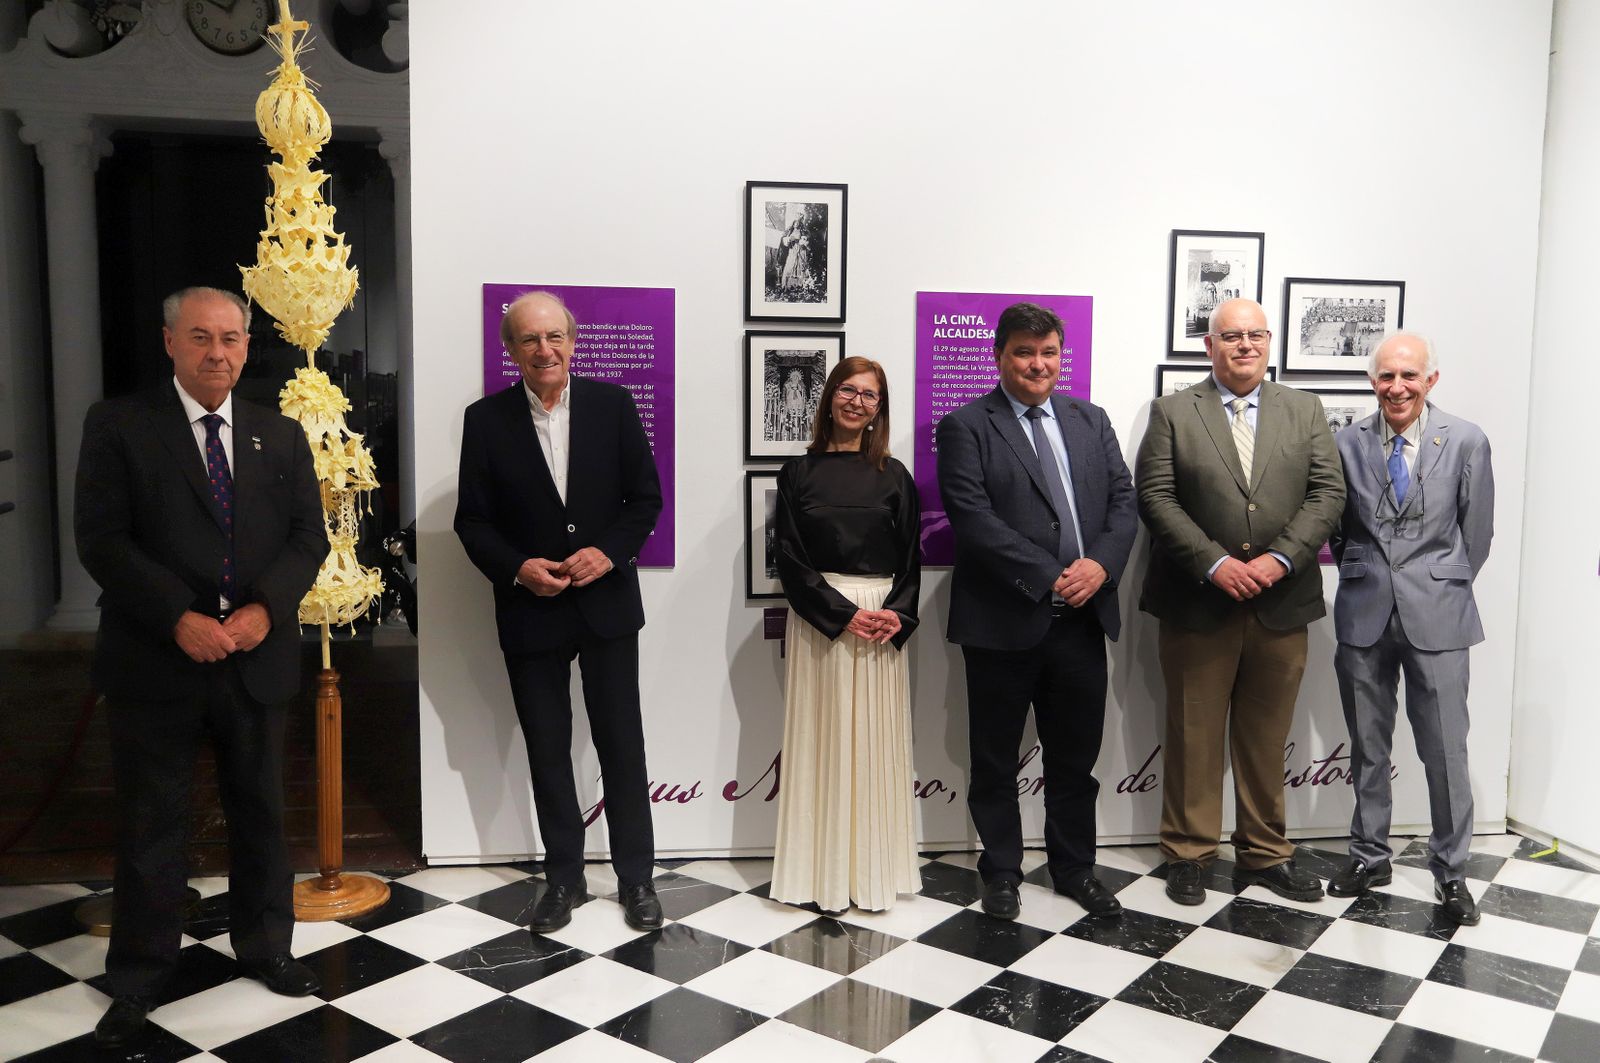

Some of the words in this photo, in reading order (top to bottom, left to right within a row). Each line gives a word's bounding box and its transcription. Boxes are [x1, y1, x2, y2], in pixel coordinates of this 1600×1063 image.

[196, 2, 204, 14] 9
[256, 8, 263, 19] 3
[201, 17, 208, 30] 8
[214, 28, 222, 40] 7
[226, 32, 234, 44] 6
[240, 30, 248, 42] 5
[934, 314, 948, 324] LA
[950, 315, 986, 326] CINTA.
[933, 328, 996, 339] ALCALDESA
[604, 342, 618, 350] deja
[1116, 744, 1162, 794] de
